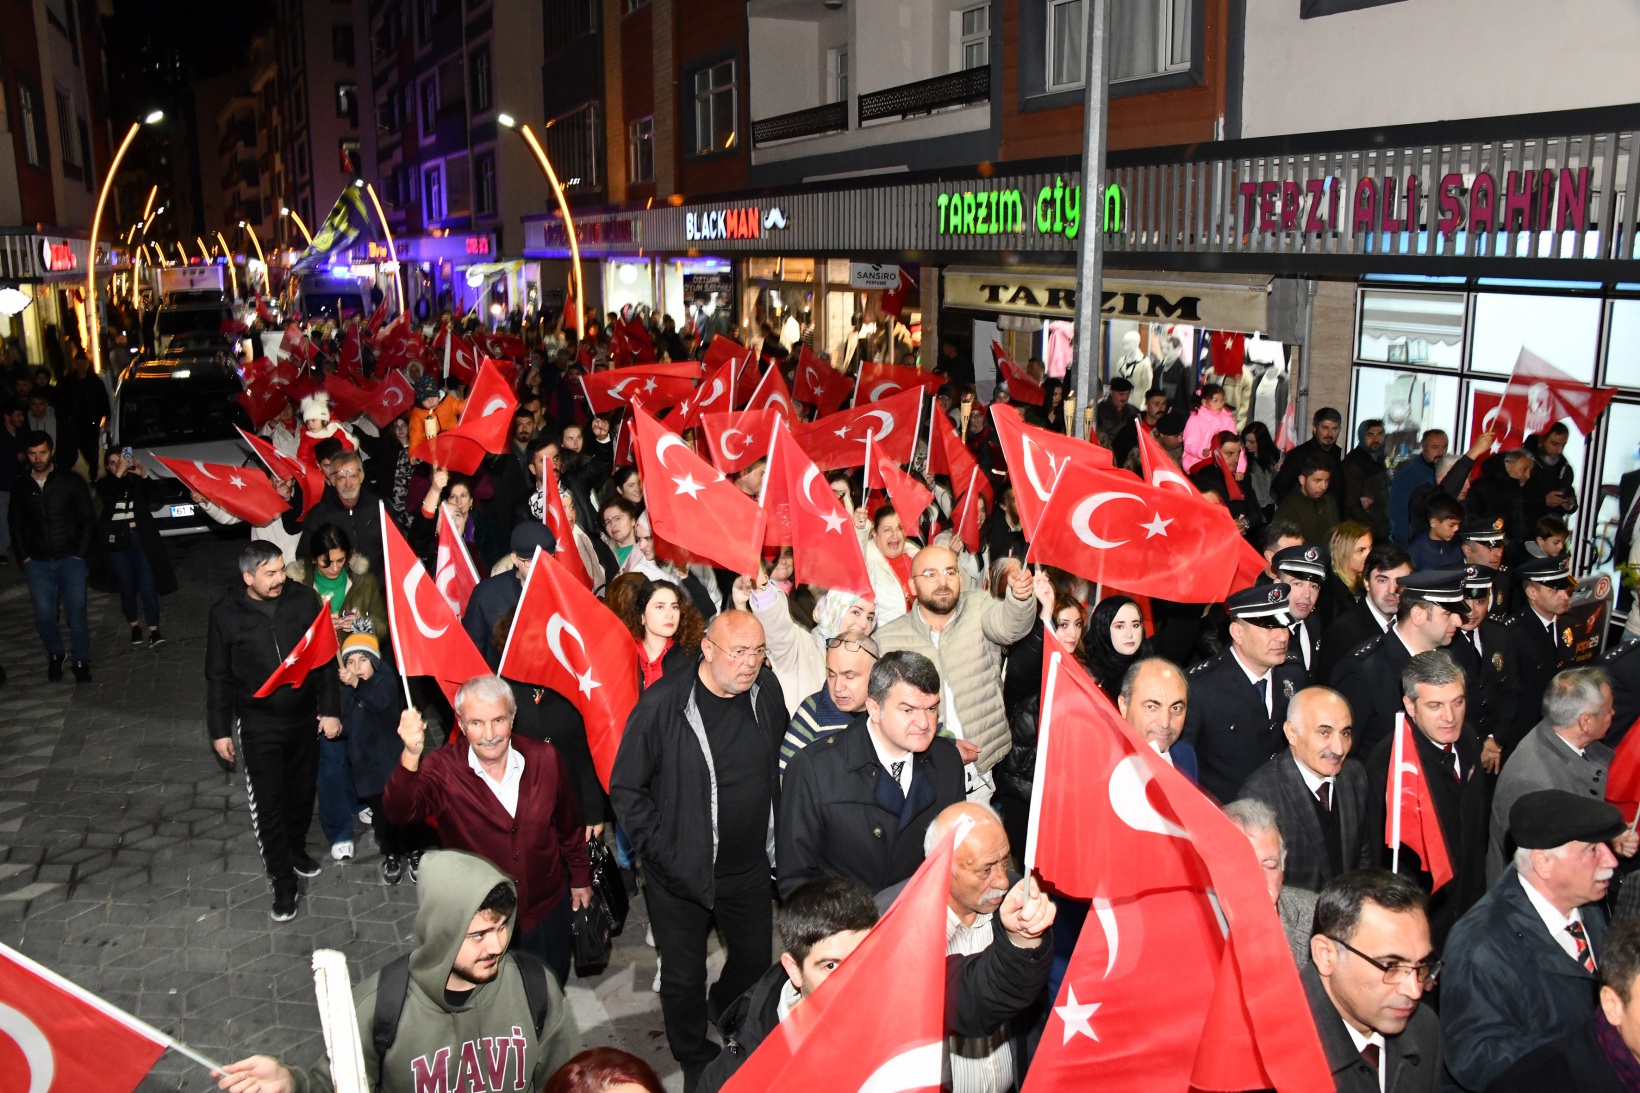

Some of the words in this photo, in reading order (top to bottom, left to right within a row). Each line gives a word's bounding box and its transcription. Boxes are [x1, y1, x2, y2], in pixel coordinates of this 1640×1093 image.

[686, 206, 759, 241] BLACKMAN
[937, 188, 1022, 234] TARZIM
[1240, 176, 1338, 233] TERZİ
[1353, 174, 1416, 233] ALİ
[1438, 166, 1589, 241] ŞAHİN
[411, 1025, 527, 1093] MAVİ
